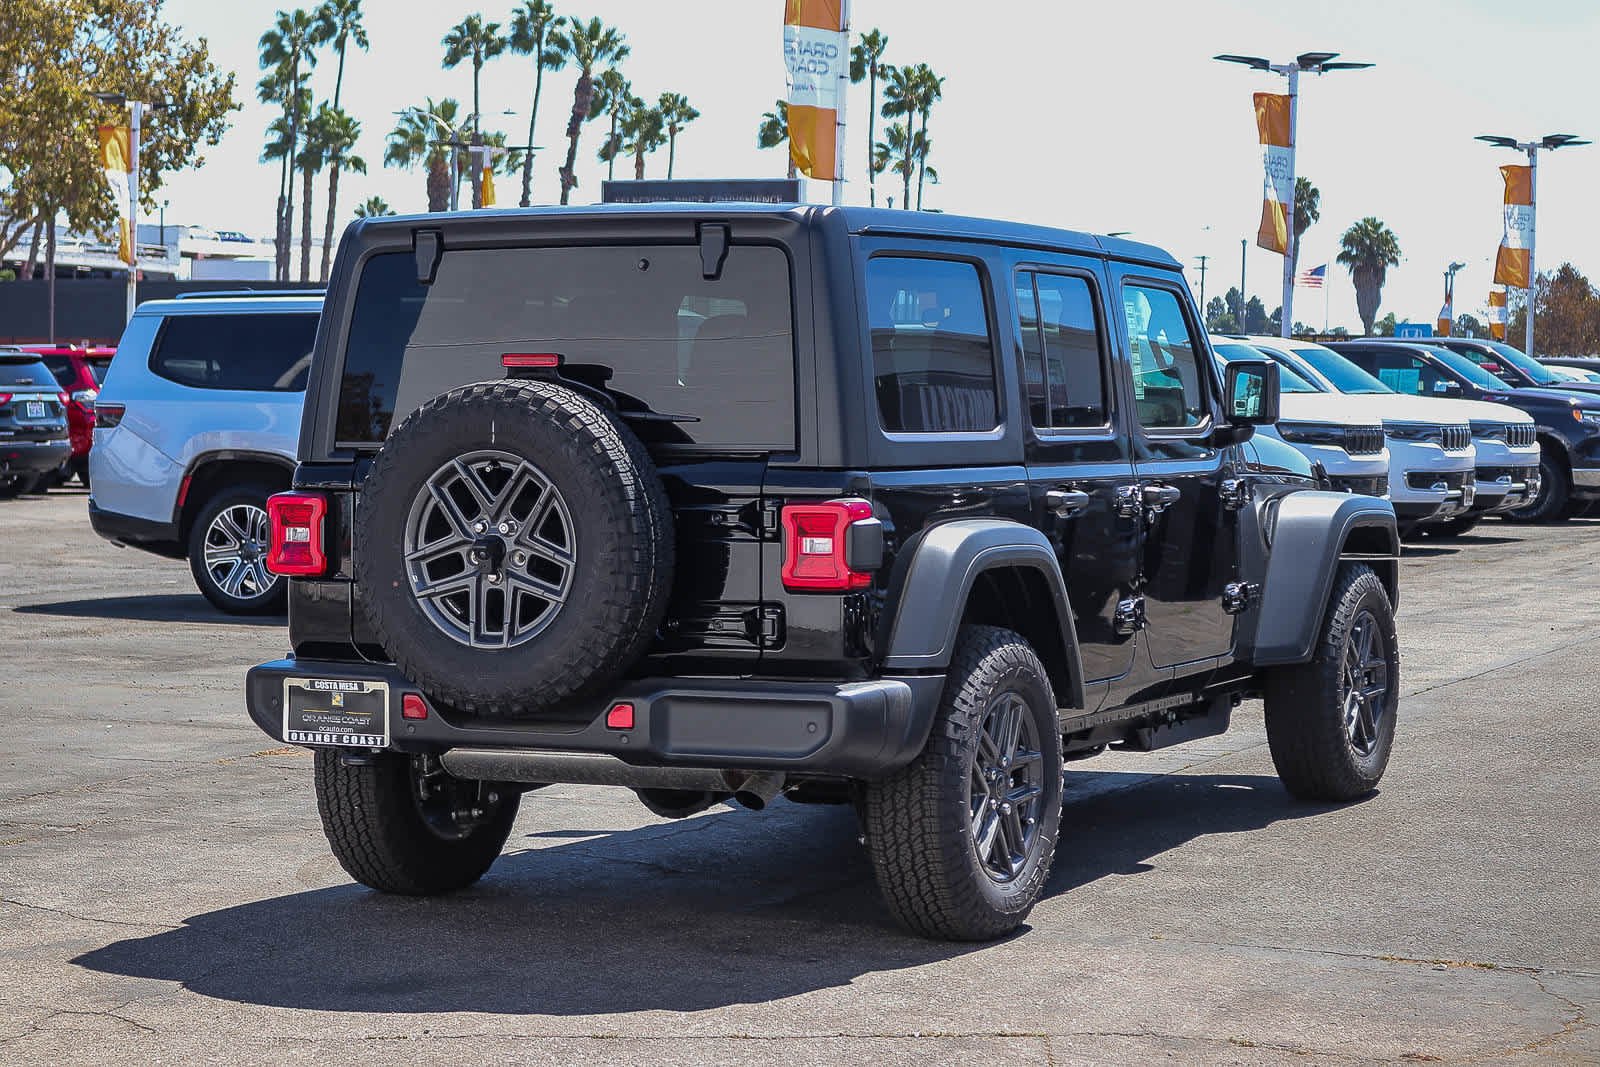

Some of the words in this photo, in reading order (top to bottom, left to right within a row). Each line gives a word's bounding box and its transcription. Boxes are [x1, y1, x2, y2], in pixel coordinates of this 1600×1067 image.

[315, 681, 340, 690] COSTA
[341, 682, 359, 691] MESA
[318, 725, 354, 733] ocauto.com
[290, 732, 338, 744] ORANGE
[342, 736, 382, 746] COAST
